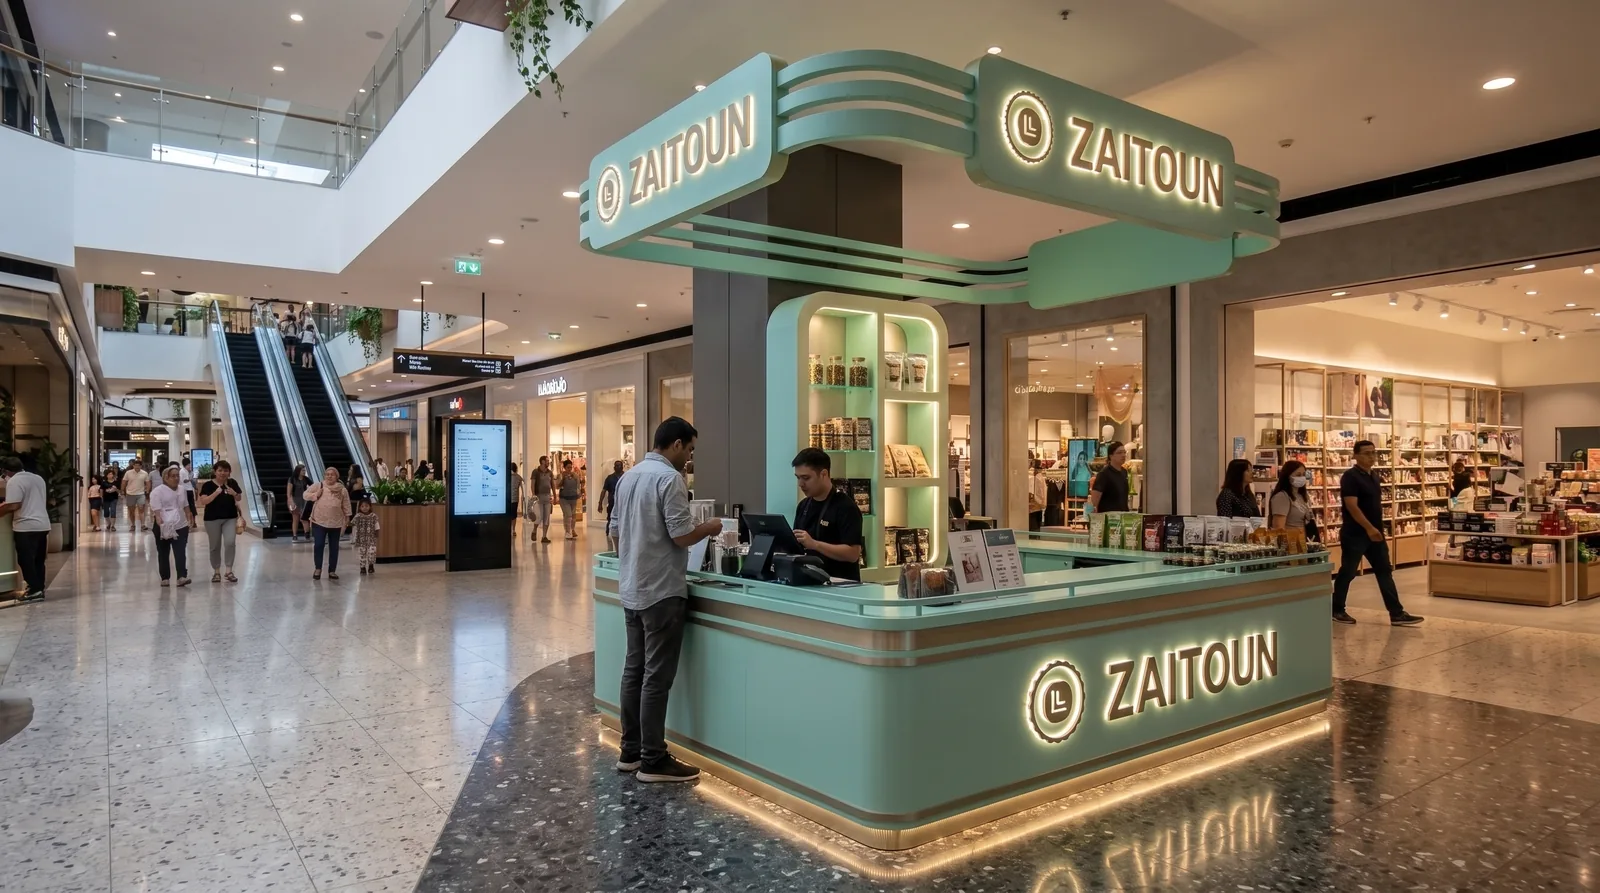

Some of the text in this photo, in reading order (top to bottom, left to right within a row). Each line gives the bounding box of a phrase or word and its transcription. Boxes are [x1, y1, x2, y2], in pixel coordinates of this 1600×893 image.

[628, 95, 752, 203] ZAITOUN
[1070, 117, 1224, 207] ZAITOUN
[1107, 630, 1278, 720] ZAITOUN
